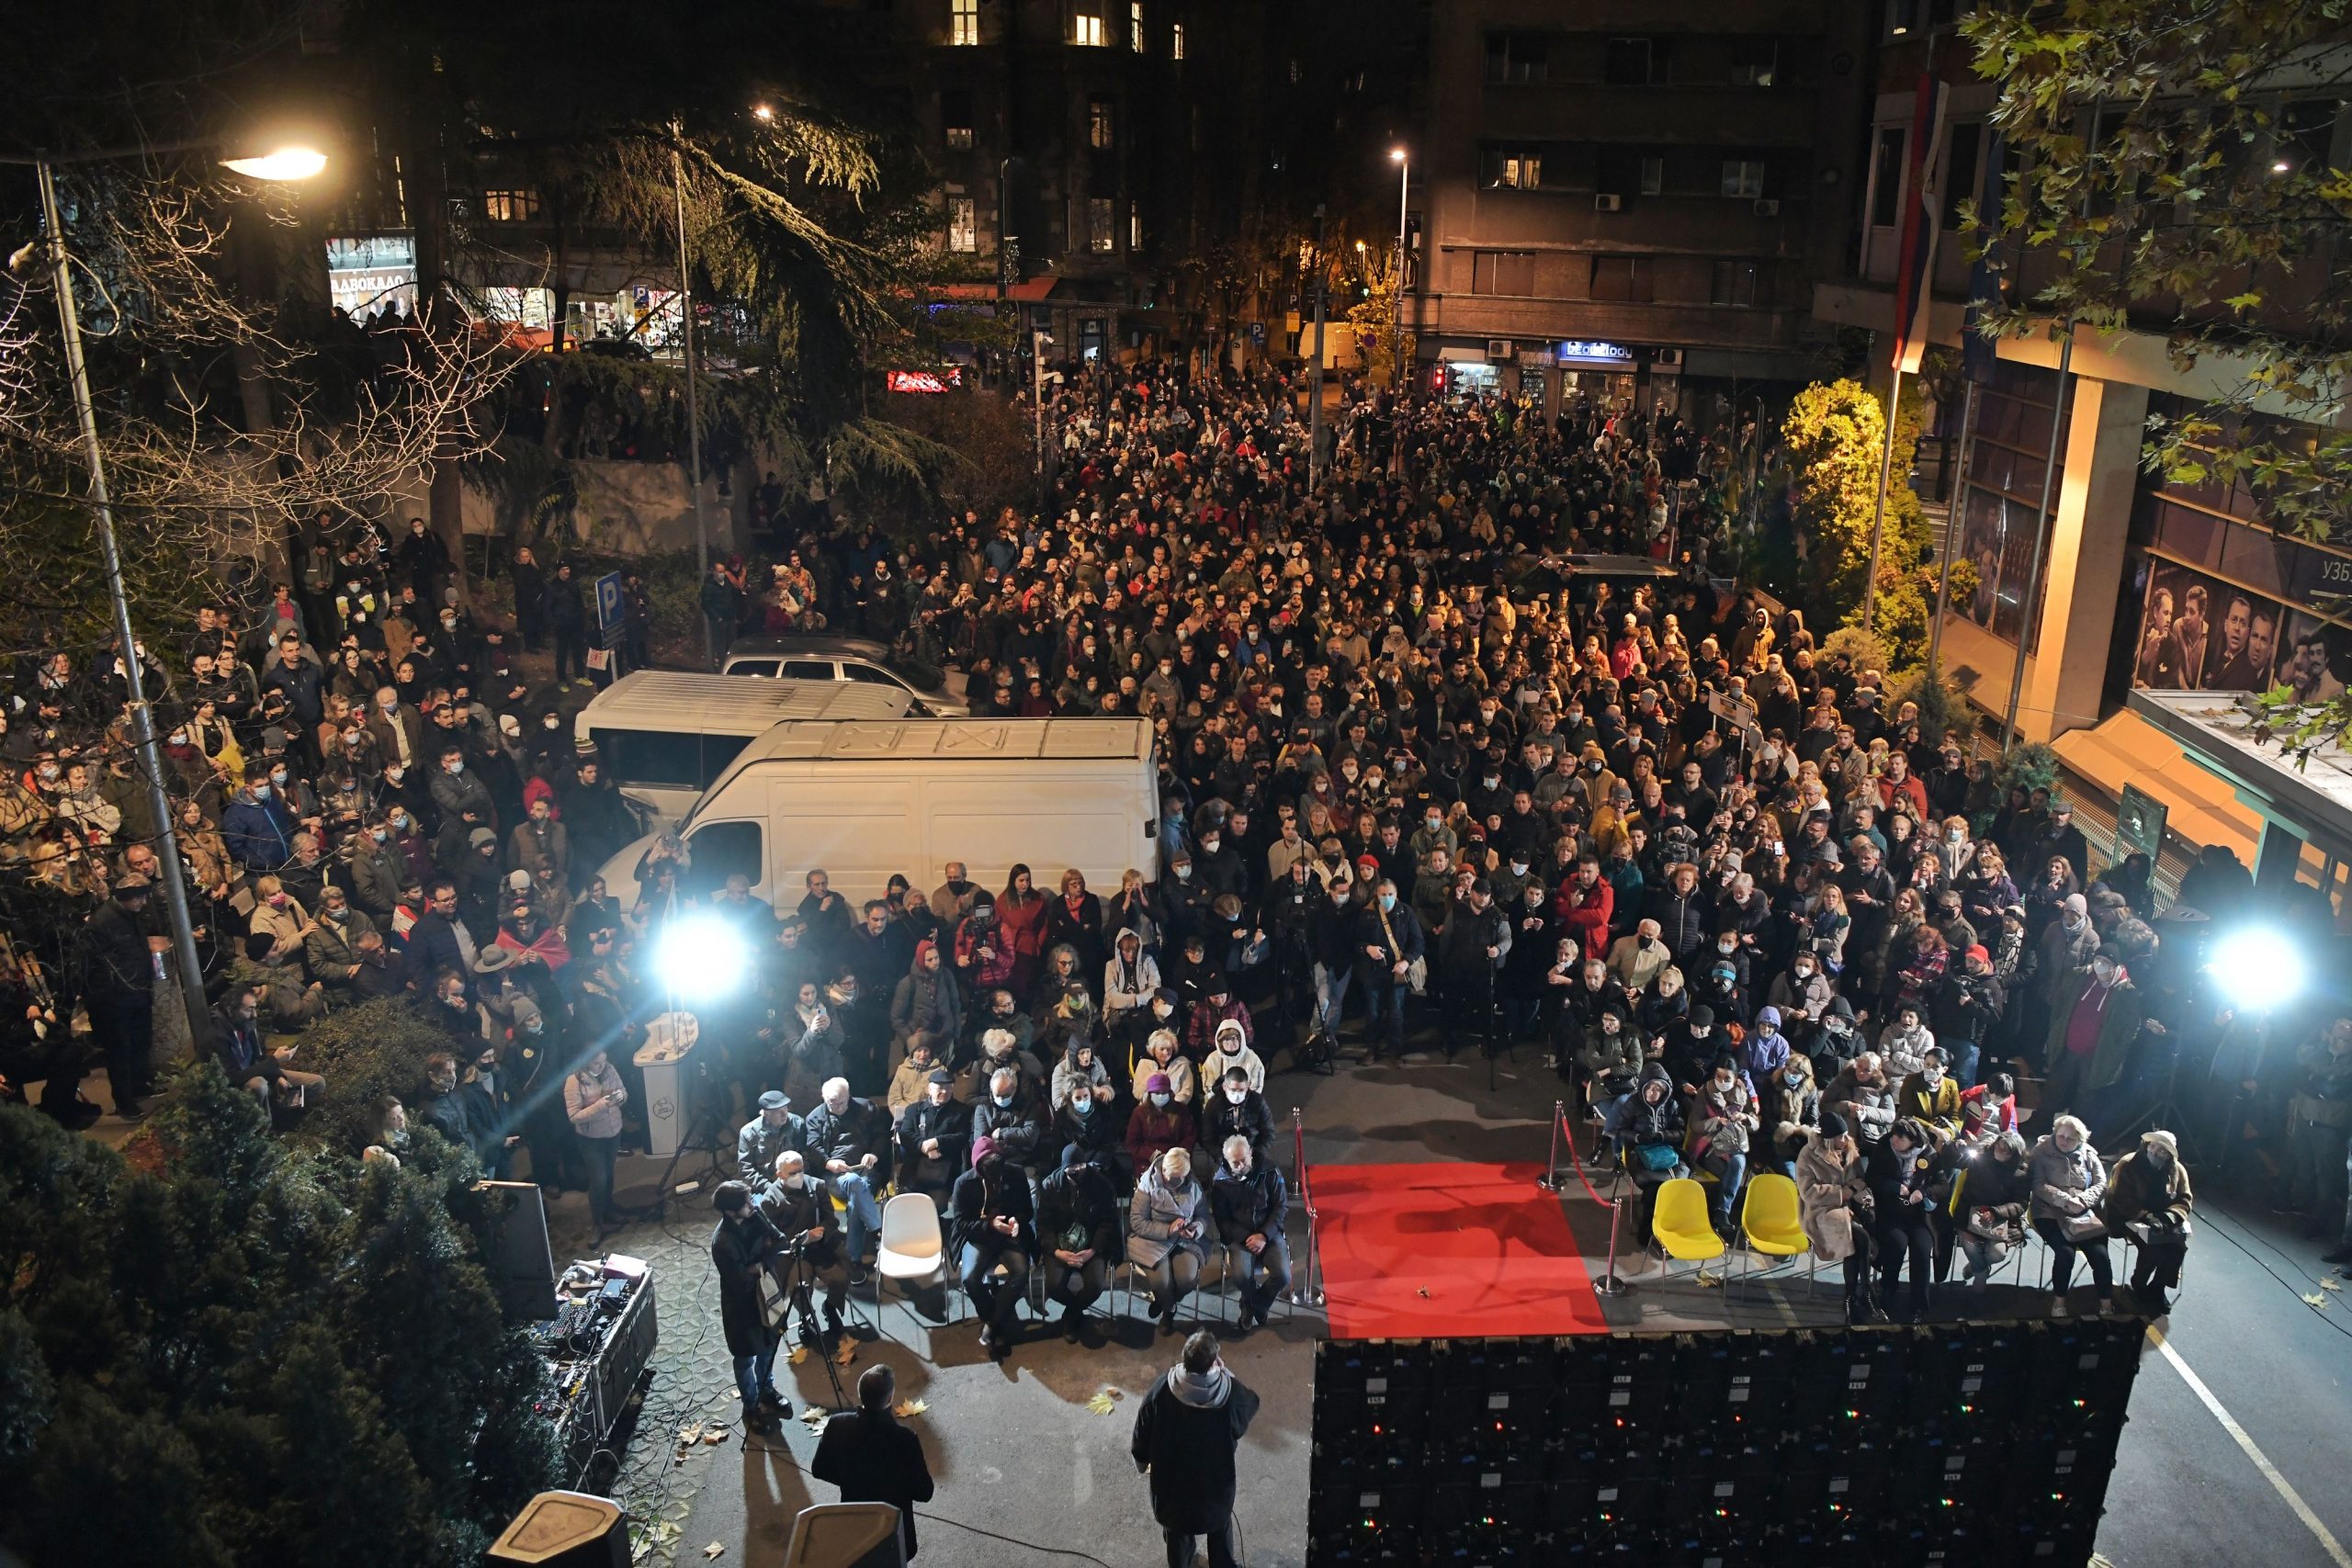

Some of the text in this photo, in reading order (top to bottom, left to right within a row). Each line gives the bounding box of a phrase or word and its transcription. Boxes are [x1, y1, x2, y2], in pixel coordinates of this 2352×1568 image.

[637, 287, 646, 300] P
[1289, 294, 1297, 305] P
[1252, 324, 1261, 335] P
[2322, 560, 2352, 582] УЗБ
[603, 581, 617, 622] P
